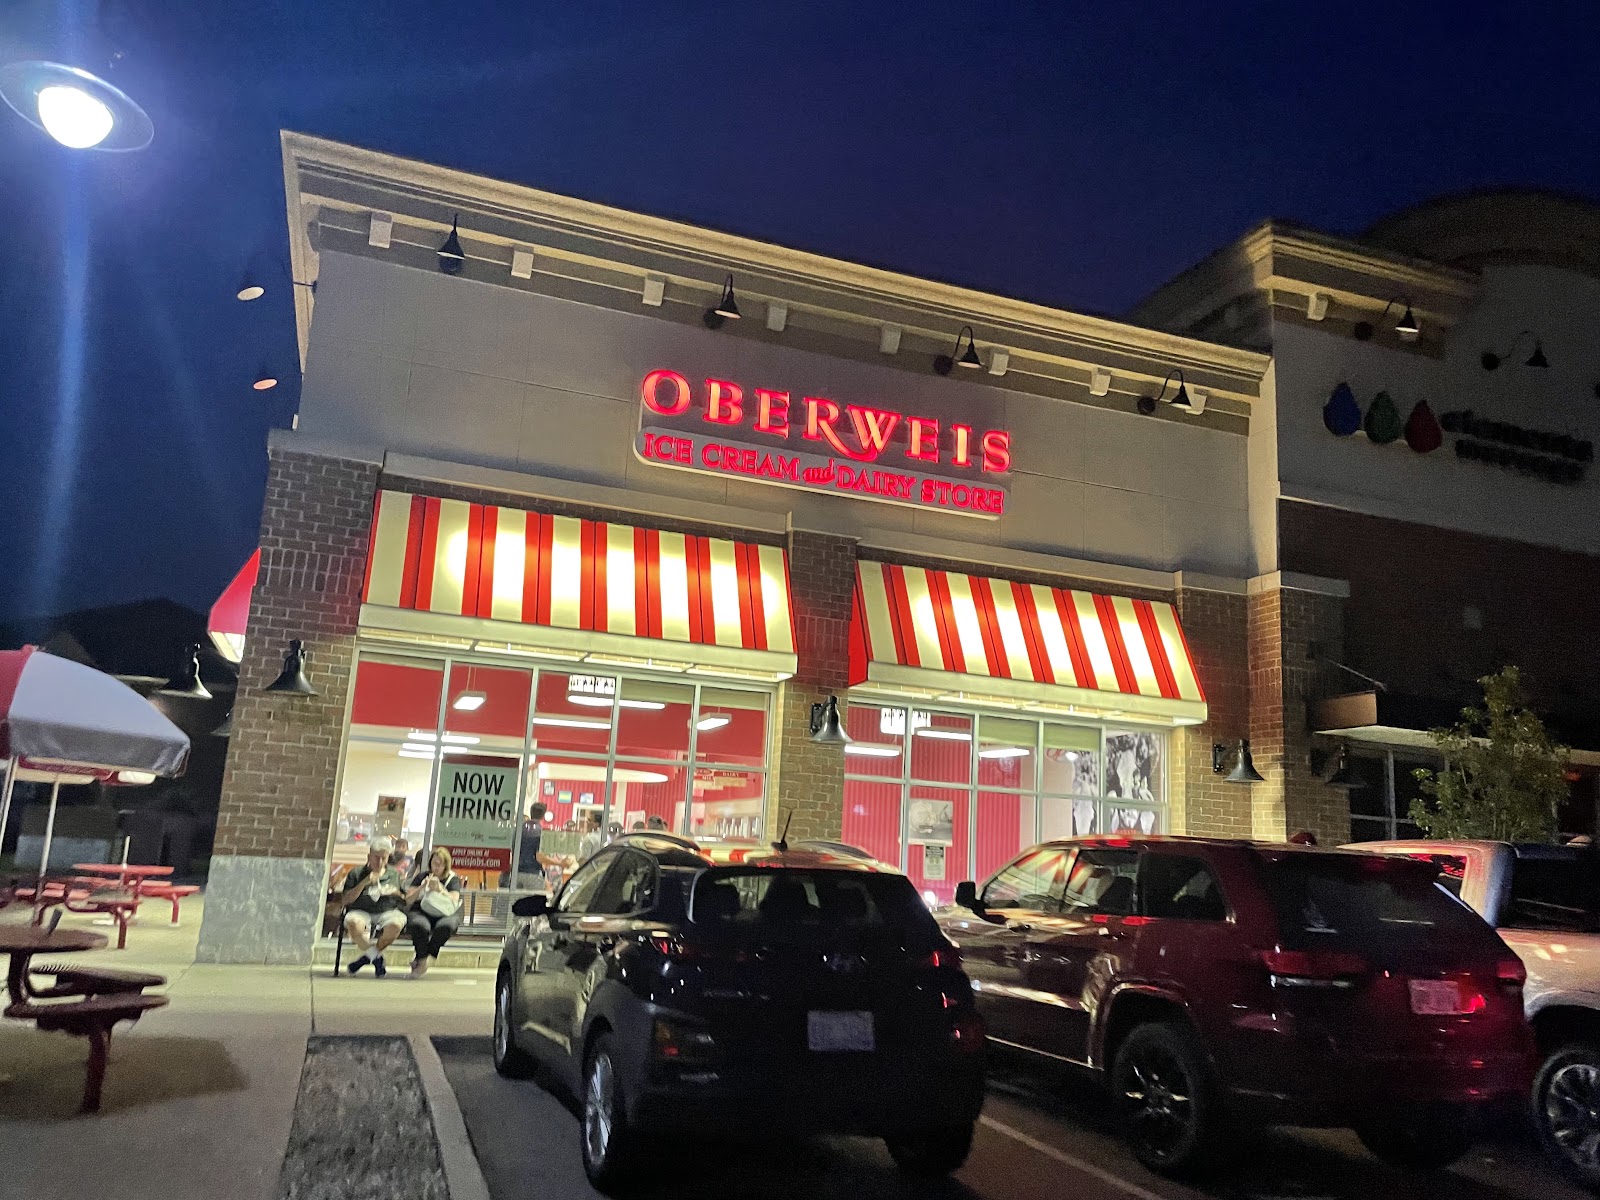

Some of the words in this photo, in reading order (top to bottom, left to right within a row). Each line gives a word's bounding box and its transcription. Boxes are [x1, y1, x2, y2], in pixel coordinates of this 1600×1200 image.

[642, 369, 1011, 473] OBERWEIS
[643, 432, 694, 465] ICE
[701, 442, 800, 482] CREAM
[802, 458, 836, 485] and
[836, 465, 917, 500] DAIRY
[920, 478, 1005, 515] STORE
[453, 772, 504, 795] NOW
[440, 797, 511, 820] HIRING
[451, 857, 501, 868] rweisjobs.com
